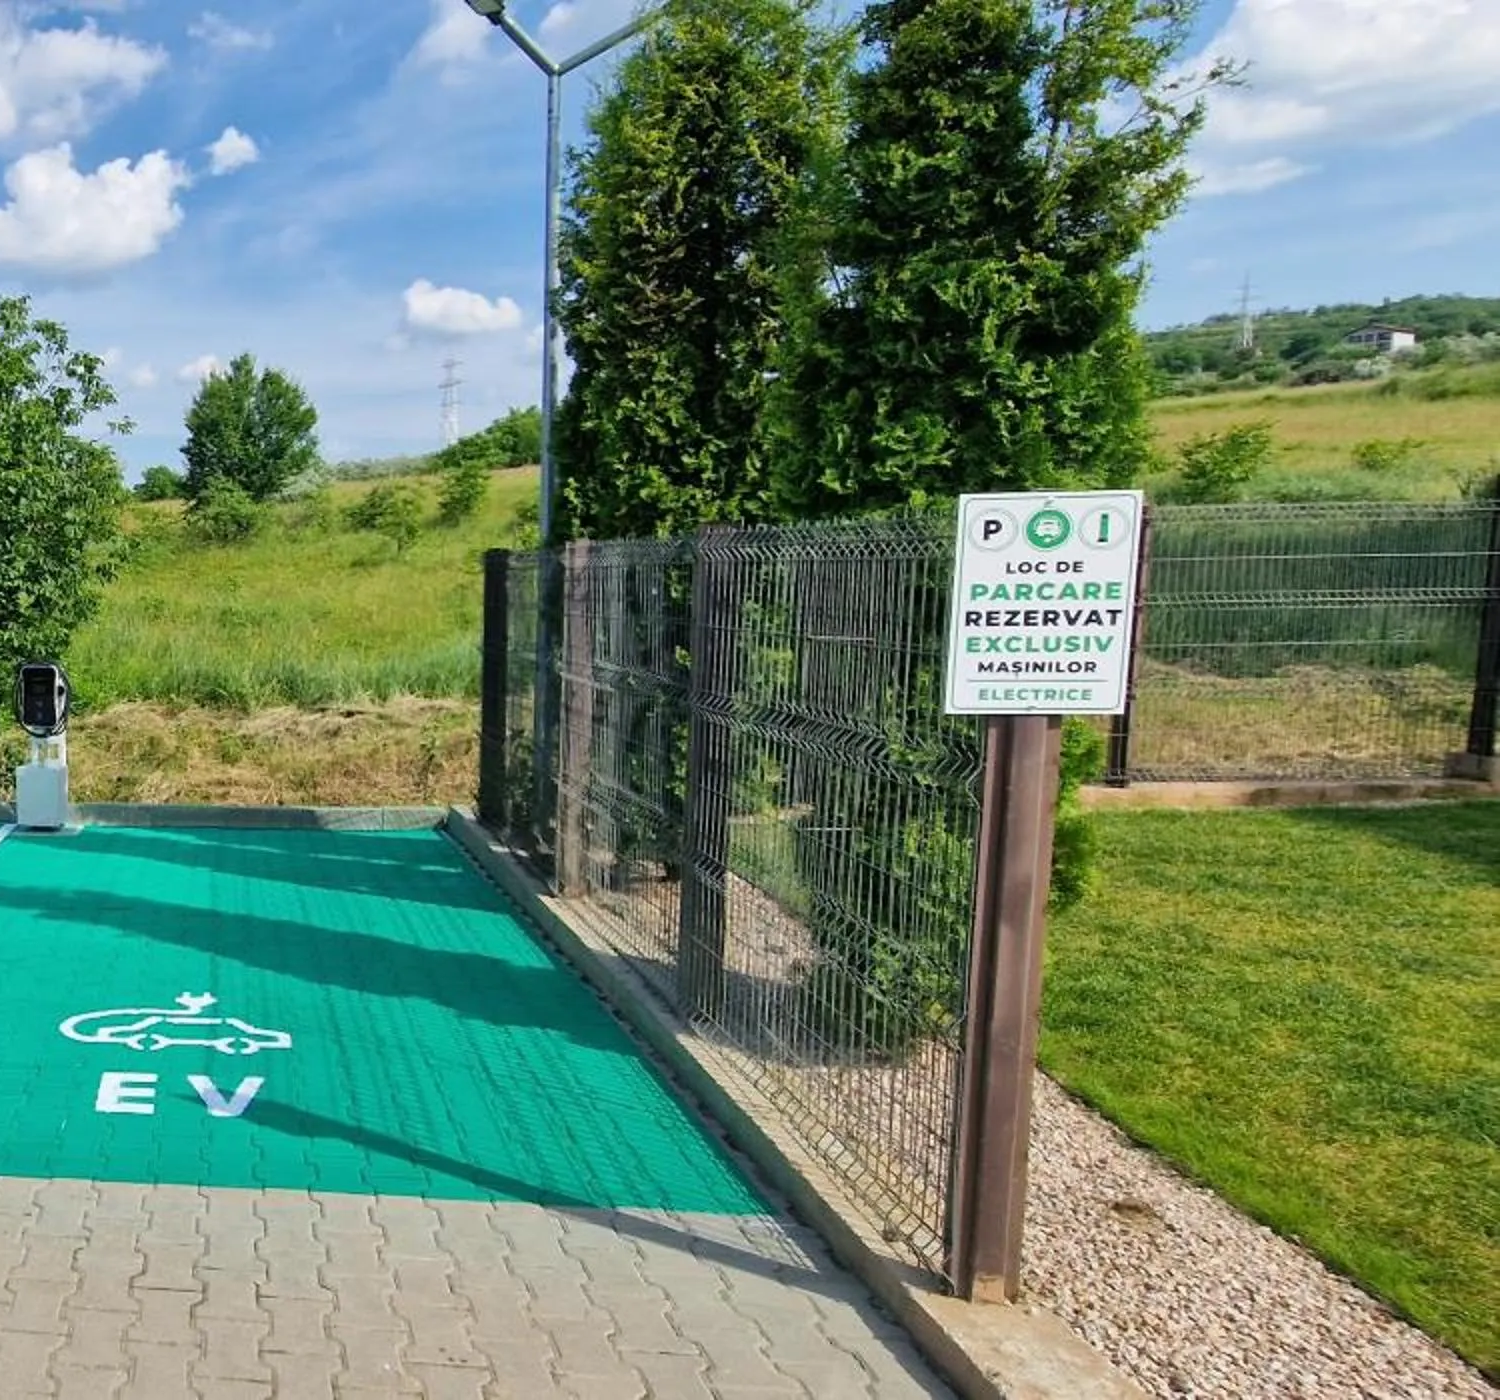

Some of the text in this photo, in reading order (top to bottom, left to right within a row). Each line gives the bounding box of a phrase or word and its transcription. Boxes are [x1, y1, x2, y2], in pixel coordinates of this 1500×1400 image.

[1005, 561, 1084, 574] LOC DE
[970, 582, 1123, 601] PARCARE
[964, 609, 1123, 627] REZERVAT
[965, 635, 1114, 653] EXCLUSIV
[978, 688, 1093, 701] ELECTRICE
[95, 1072, 265, 1117] EV
